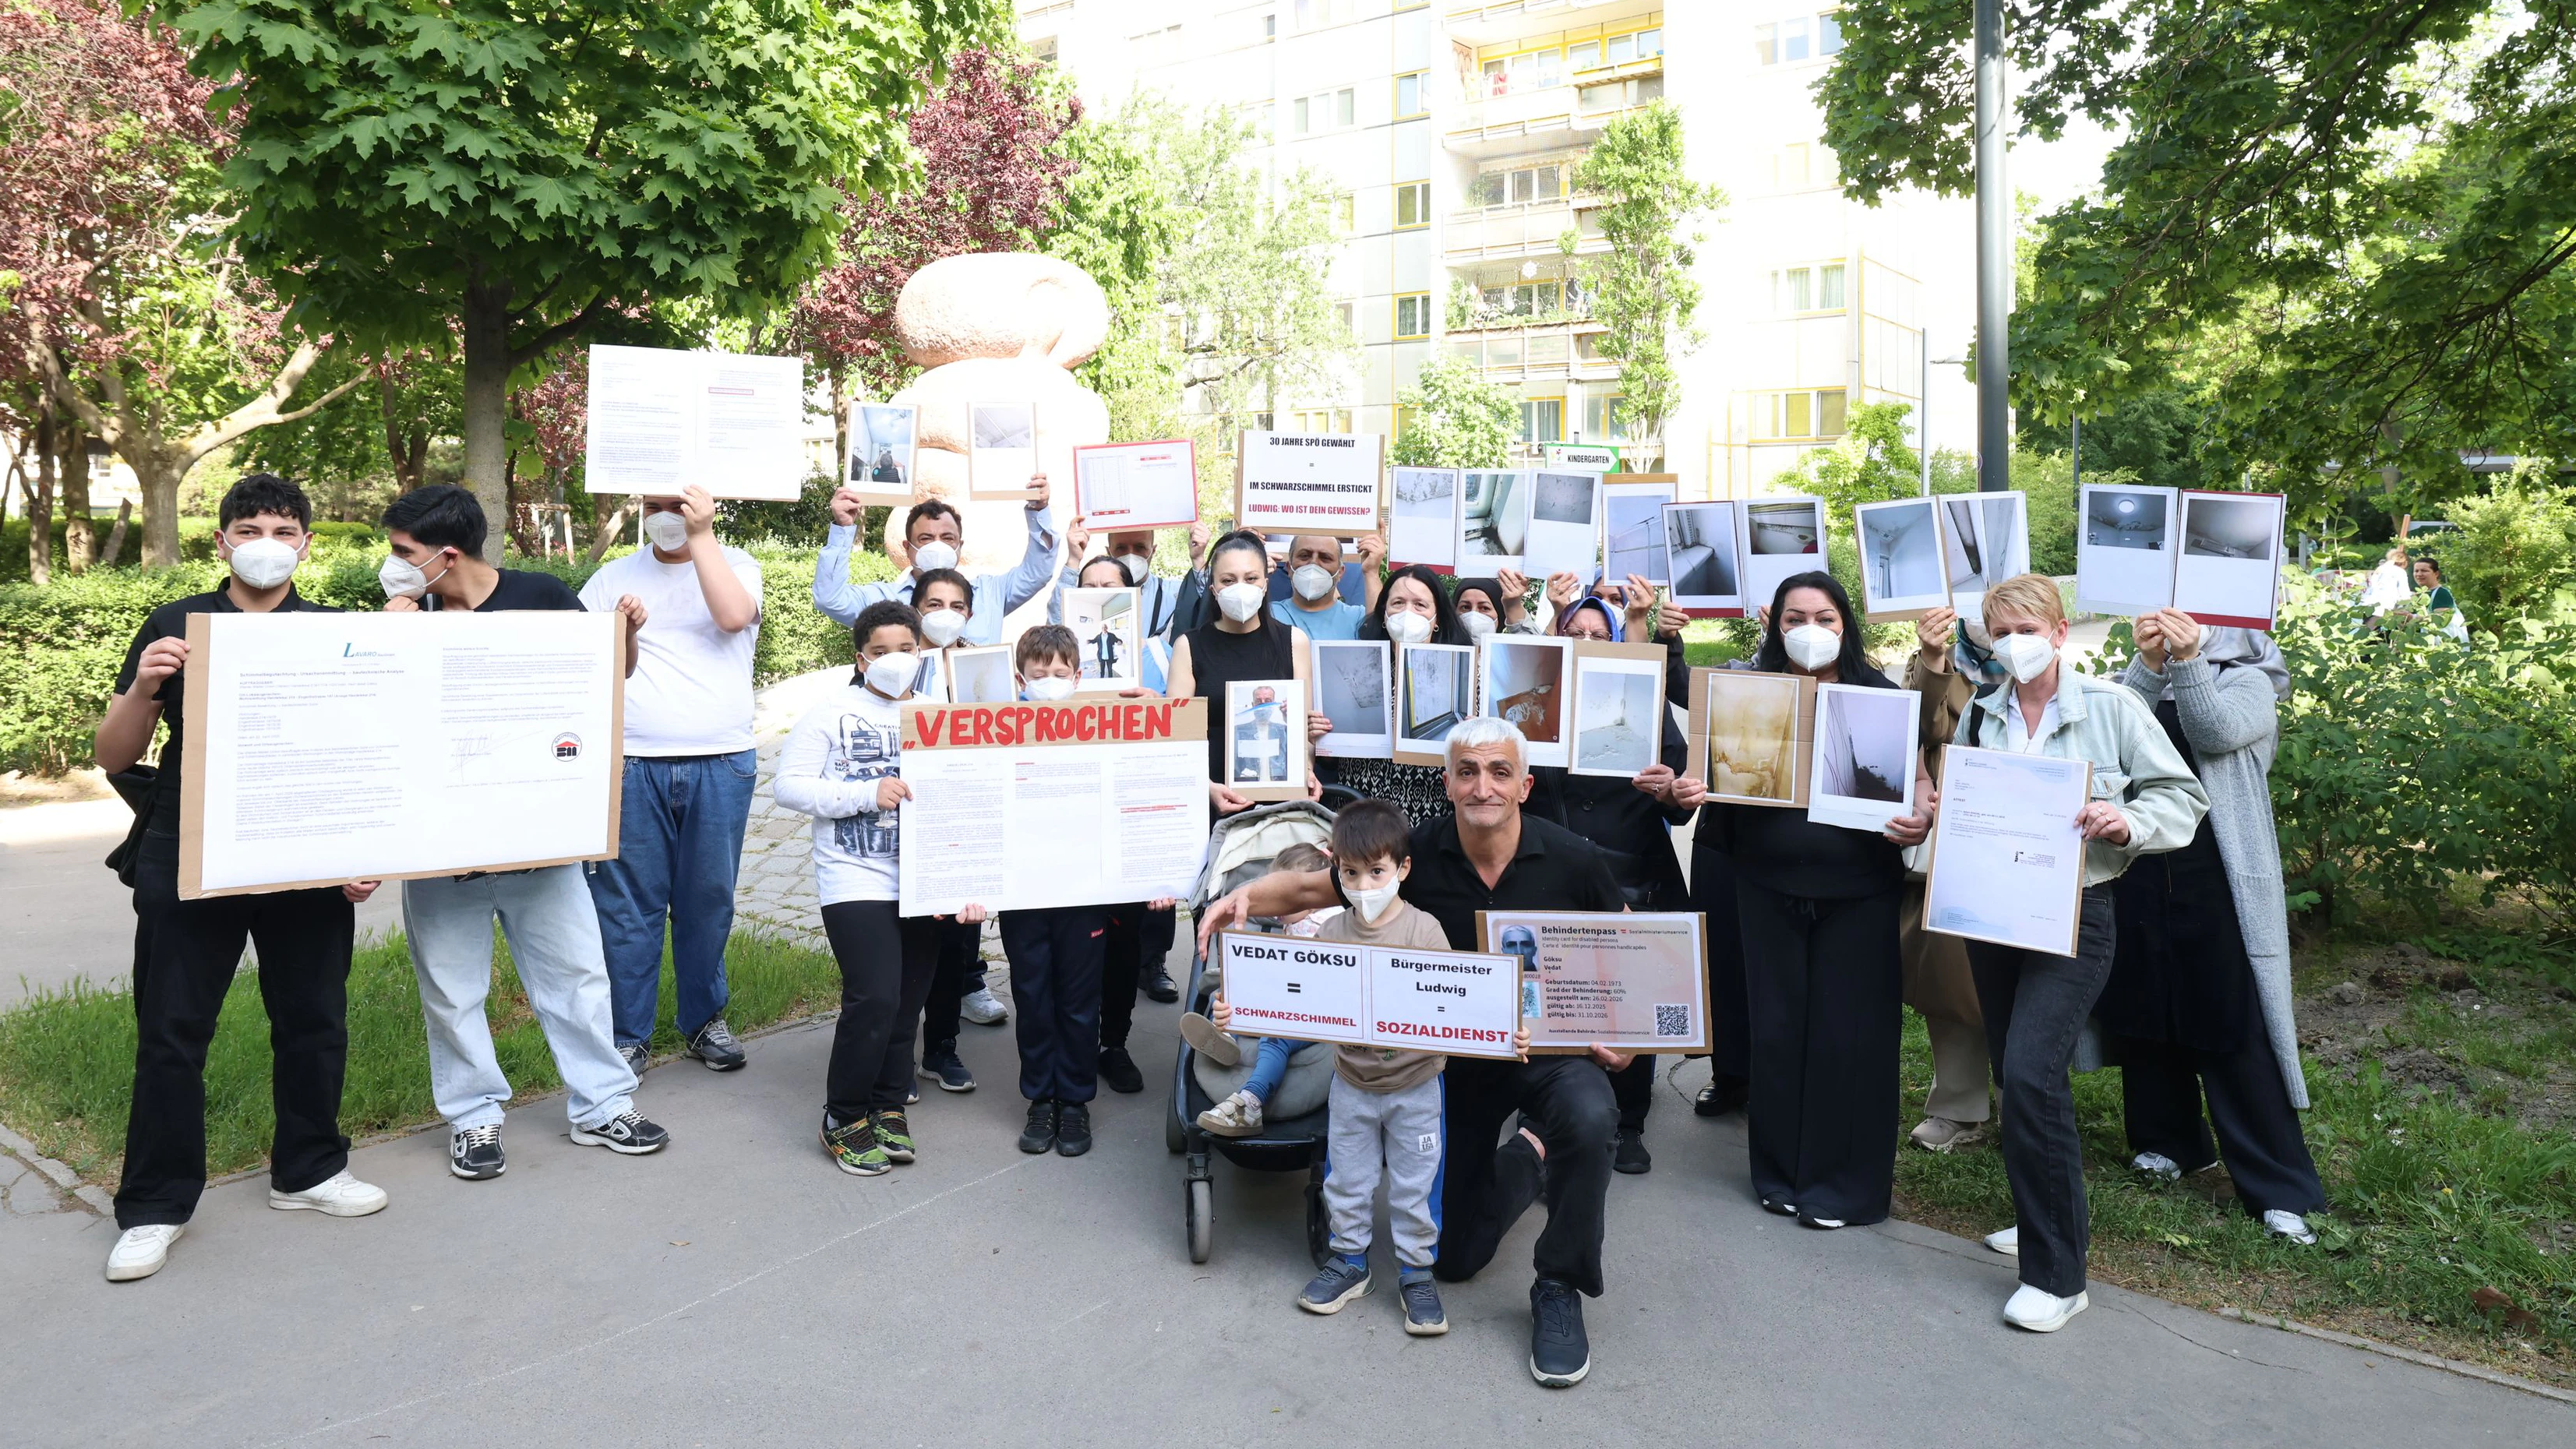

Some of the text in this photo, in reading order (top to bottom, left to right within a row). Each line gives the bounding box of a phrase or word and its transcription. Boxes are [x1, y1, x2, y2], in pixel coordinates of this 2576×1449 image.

[1270, 437, 1355, 447] 30 JAHRE SPÖ GEWÄHLT
[1567, 454, 1610, 464] KINDERGARTEN
[1250, 481, 1373, 493] IM SCHWARZSCHIMMEL ERSTICKT
[1248, 504, 1371, 516] LUDWIG: WO IST DEIN GEWISSEN?
[1541, 925, 1617, 936] Behindertenpass
[1231, 944, 1356, 968] VEDAT GÖKSU
[1391, 958, 1492, 975] Bürgermeister
[1416, 982, 1466, 997] Ludwig
[1234, 1007, 1357, 1027] SCHWARZSCHIMMEL
[1376, 1021, 1509, 1042] SOZIALDIENST
